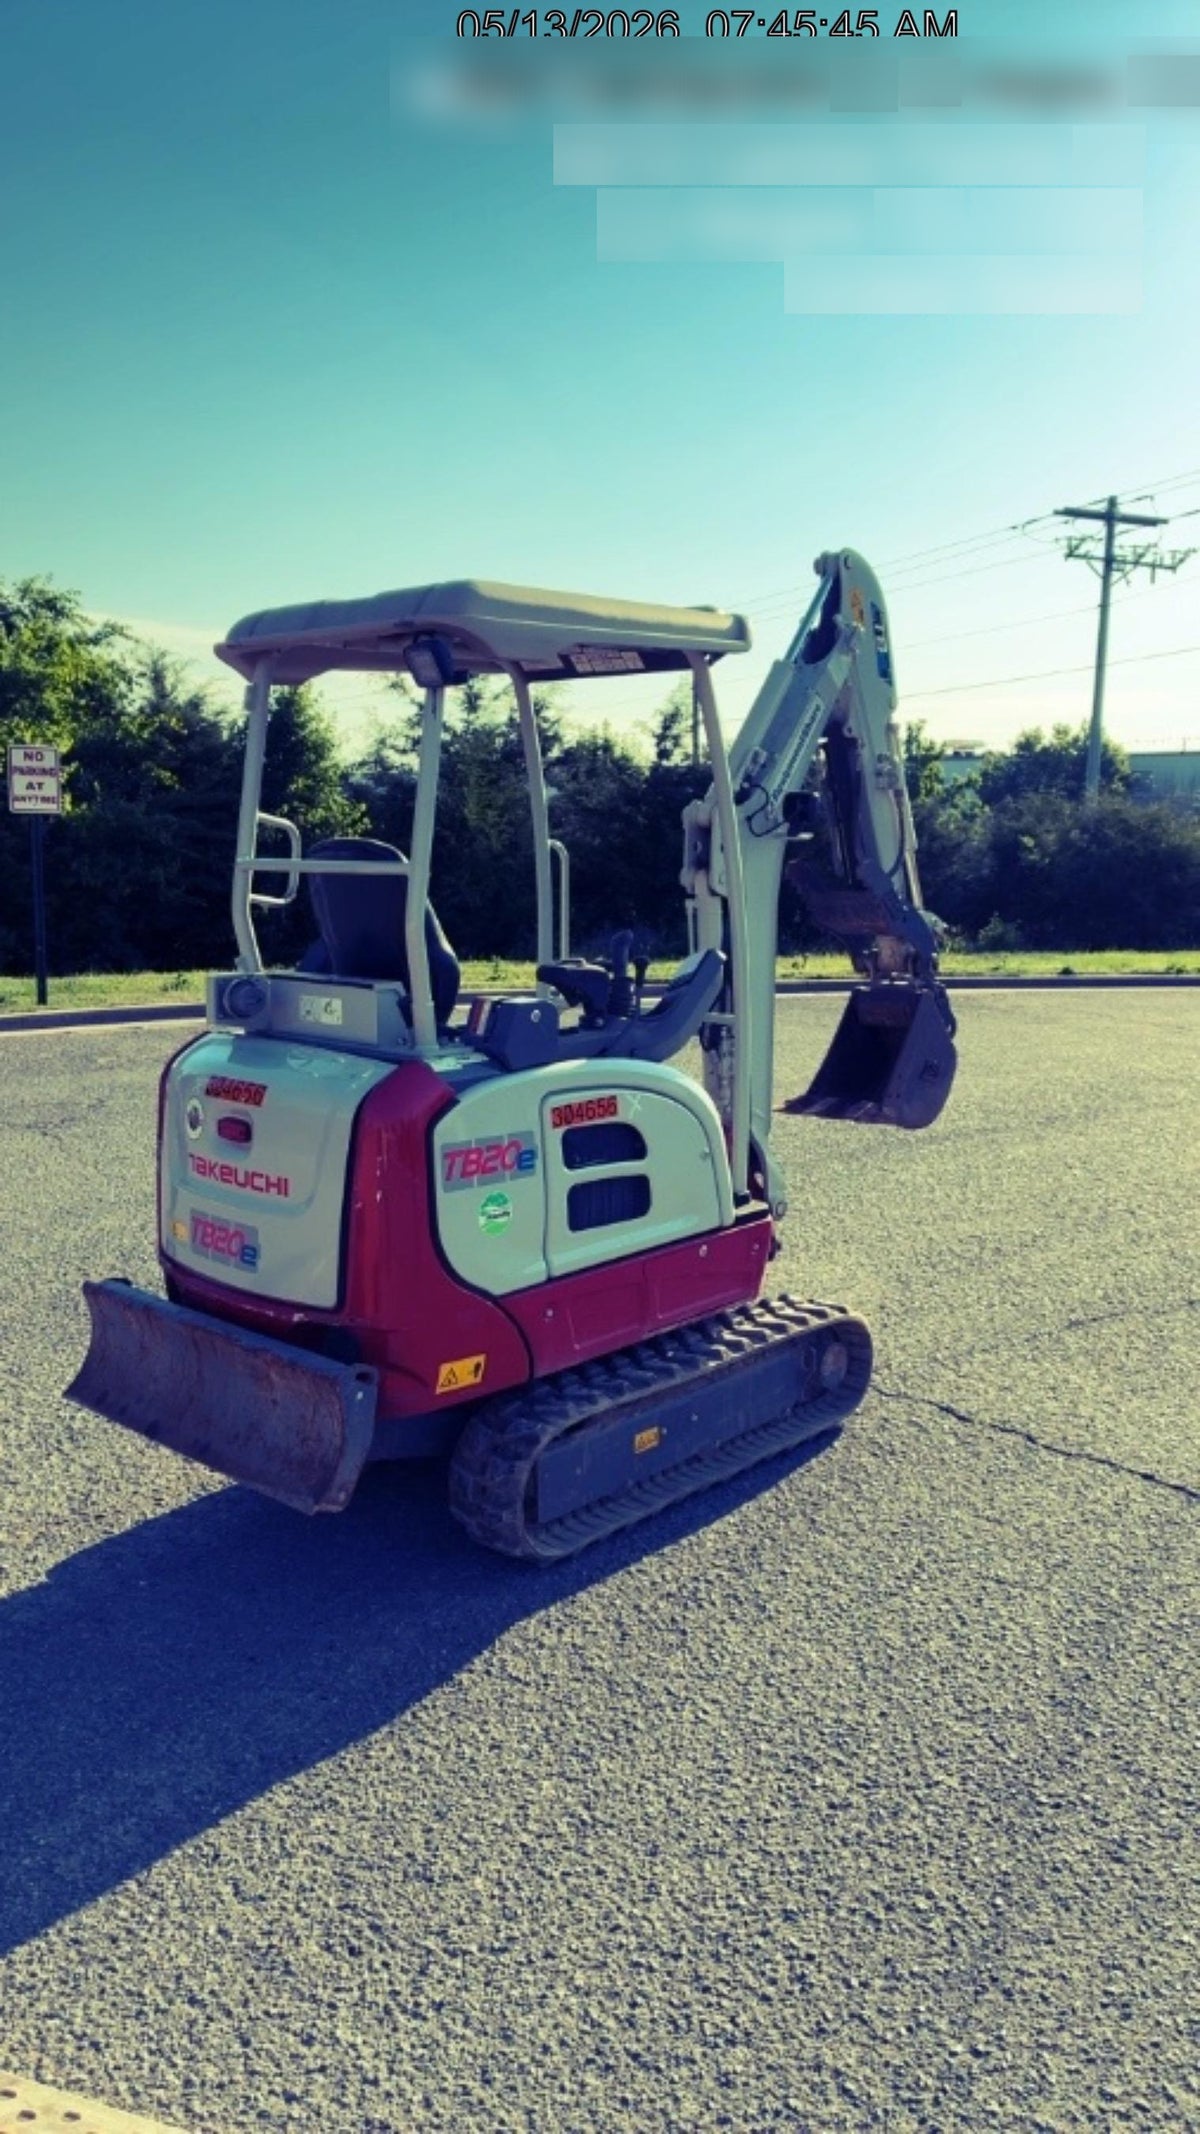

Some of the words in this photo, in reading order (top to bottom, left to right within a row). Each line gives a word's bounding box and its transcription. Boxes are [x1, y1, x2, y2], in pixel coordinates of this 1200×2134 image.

[23, 751, 44, 762] NO
[26, 782, 45, 791] AT
[552, 1095, 618, 1128] 304656
[443, 1139, 537, 1182] TB20e
[191, 1214, 258, 1267] TB20e
